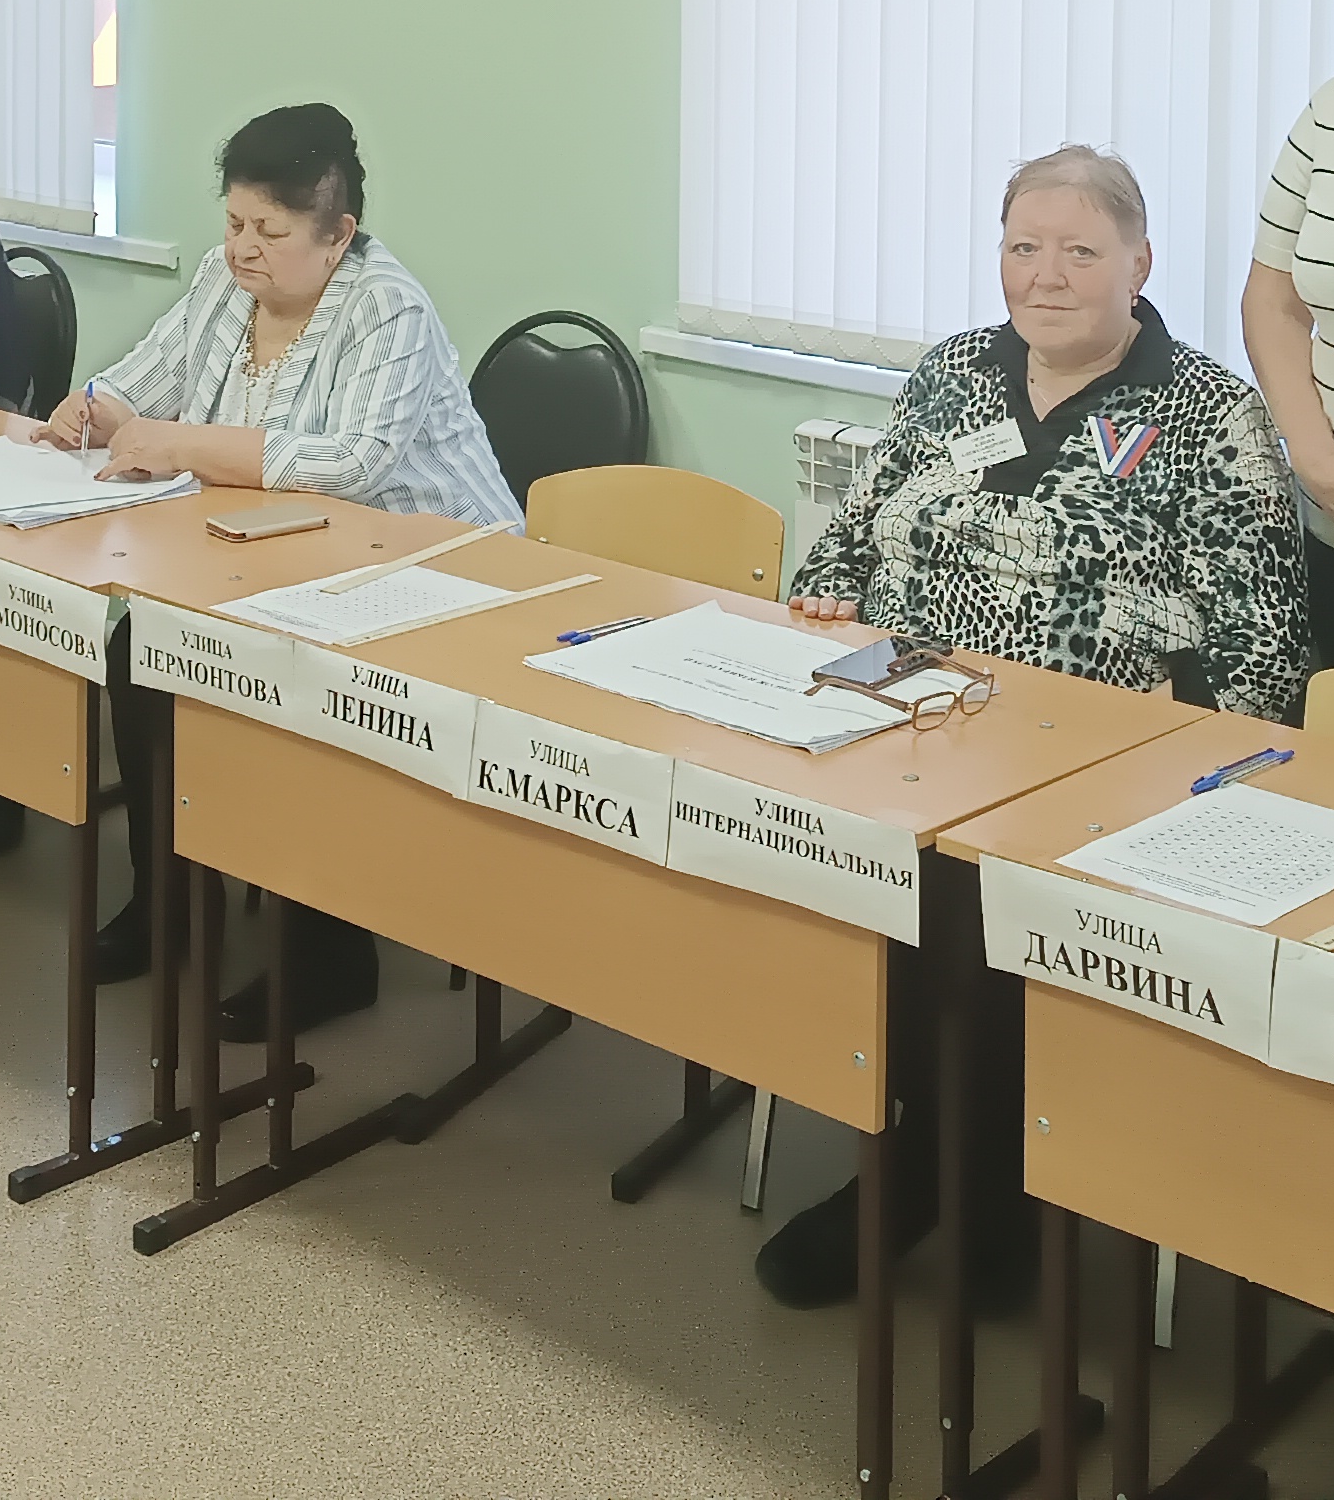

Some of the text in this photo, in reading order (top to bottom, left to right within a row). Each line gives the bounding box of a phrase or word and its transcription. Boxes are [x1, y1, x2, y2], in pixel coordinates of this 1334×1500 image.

[8, 584, 54, 614] УЛИЦА
[181, 630, 233, 661] УЛИЦА
[139, 645, 283, 708] ЛЕРМОНТОВА
[351, 665, 409, 700] УЛИЦА
[321, 688, 435, 753] ЛЕНИНА
[530, 739, 592, 778] УЛИЦА
[477, 758, 640, 840] К.МАРКСА
[754, 798, 826, 836] УЛИЦА
[675, 801, 914, 890] ИНТЕРНАЦИОНАЛЬНАЯ
[1073, 907, 1165, 957] УЛИЦА
[1024, 930, 1226, 1028] ДАРВИНА
